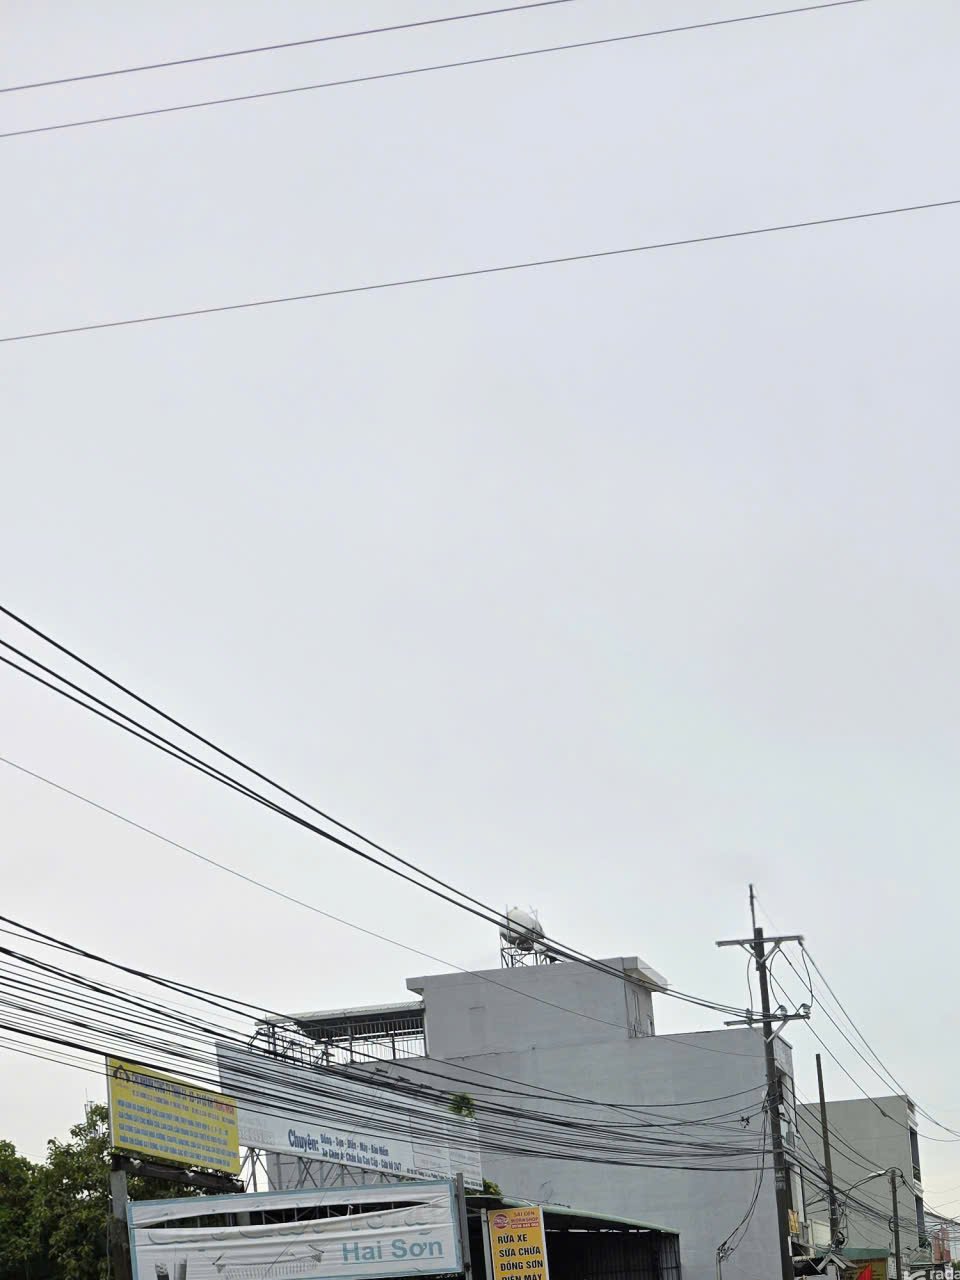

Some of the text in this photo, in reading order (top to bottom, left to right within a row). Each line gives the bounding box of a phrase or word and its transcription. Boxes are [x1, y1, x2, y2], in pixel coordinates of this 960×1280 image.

[517, 1234, 528, 1243] XE
[391, 1238, 443, 1260] Sơn
[526, 1259, 544, 1270] SƠN
